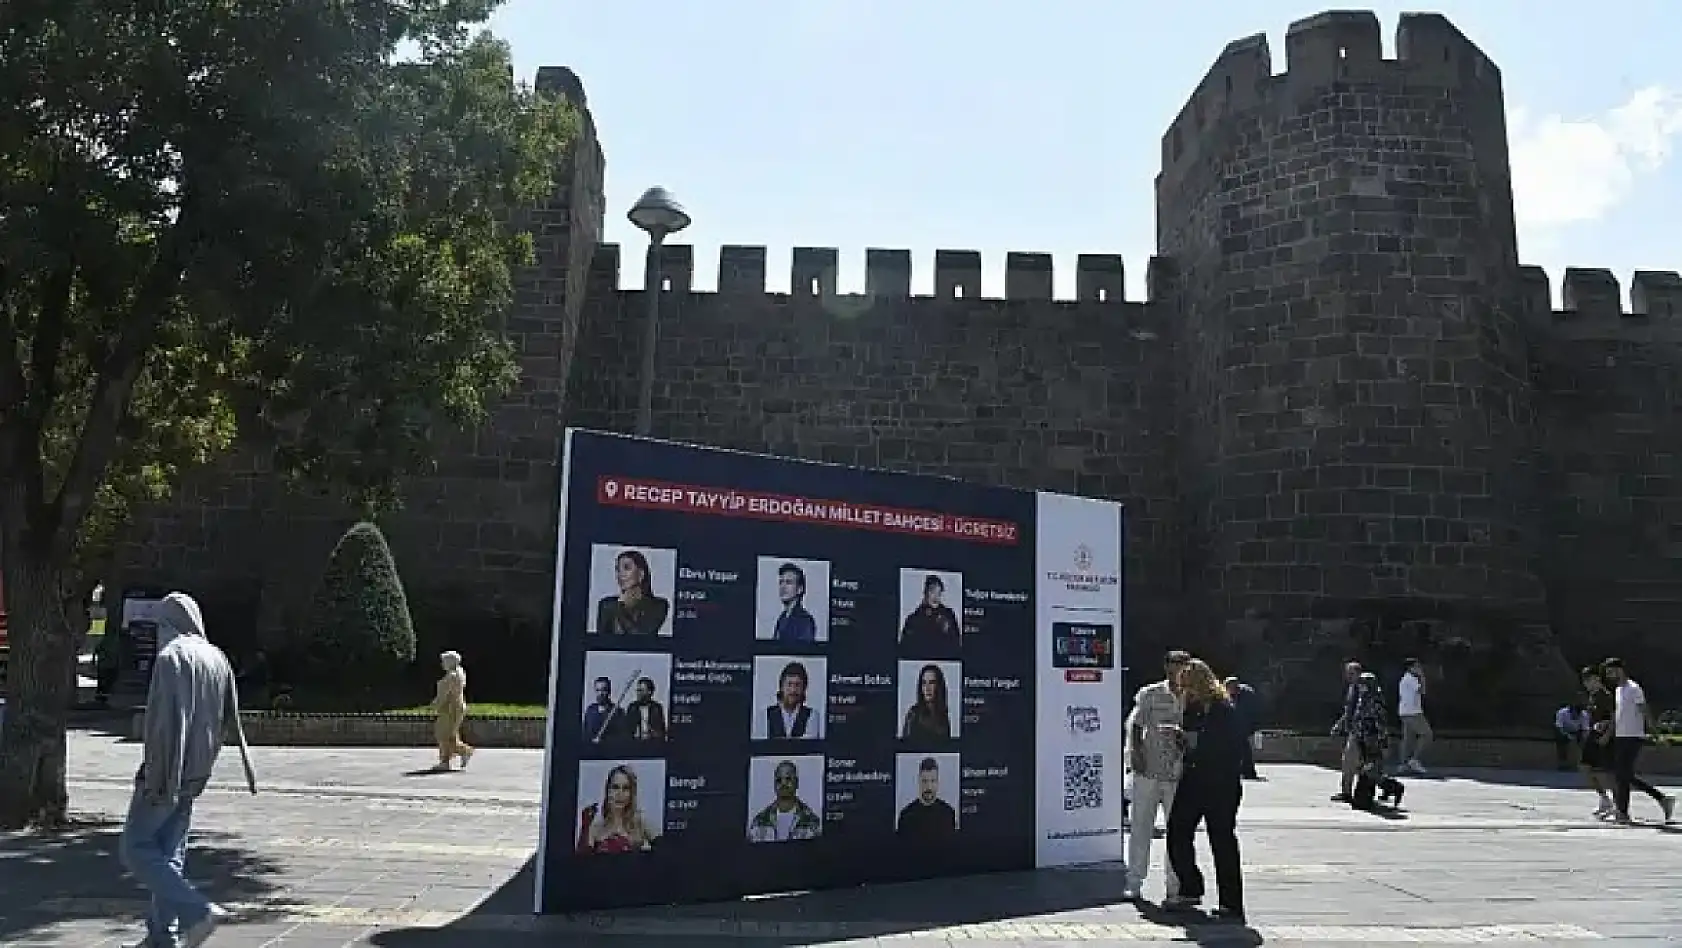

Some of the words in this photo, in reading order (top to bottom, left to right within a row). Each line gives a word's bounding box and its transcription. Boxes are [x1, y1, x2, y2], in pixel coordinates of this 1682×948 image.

[624, 484, 683, 503] RECEP
[687, 489, 745, 510] TAYYİP
[748, 497, 827, 519] ERDOĞAN
[829, 502, 883, 524] MİLLET
[883, 511, 944, 532] BAHÇESİ
